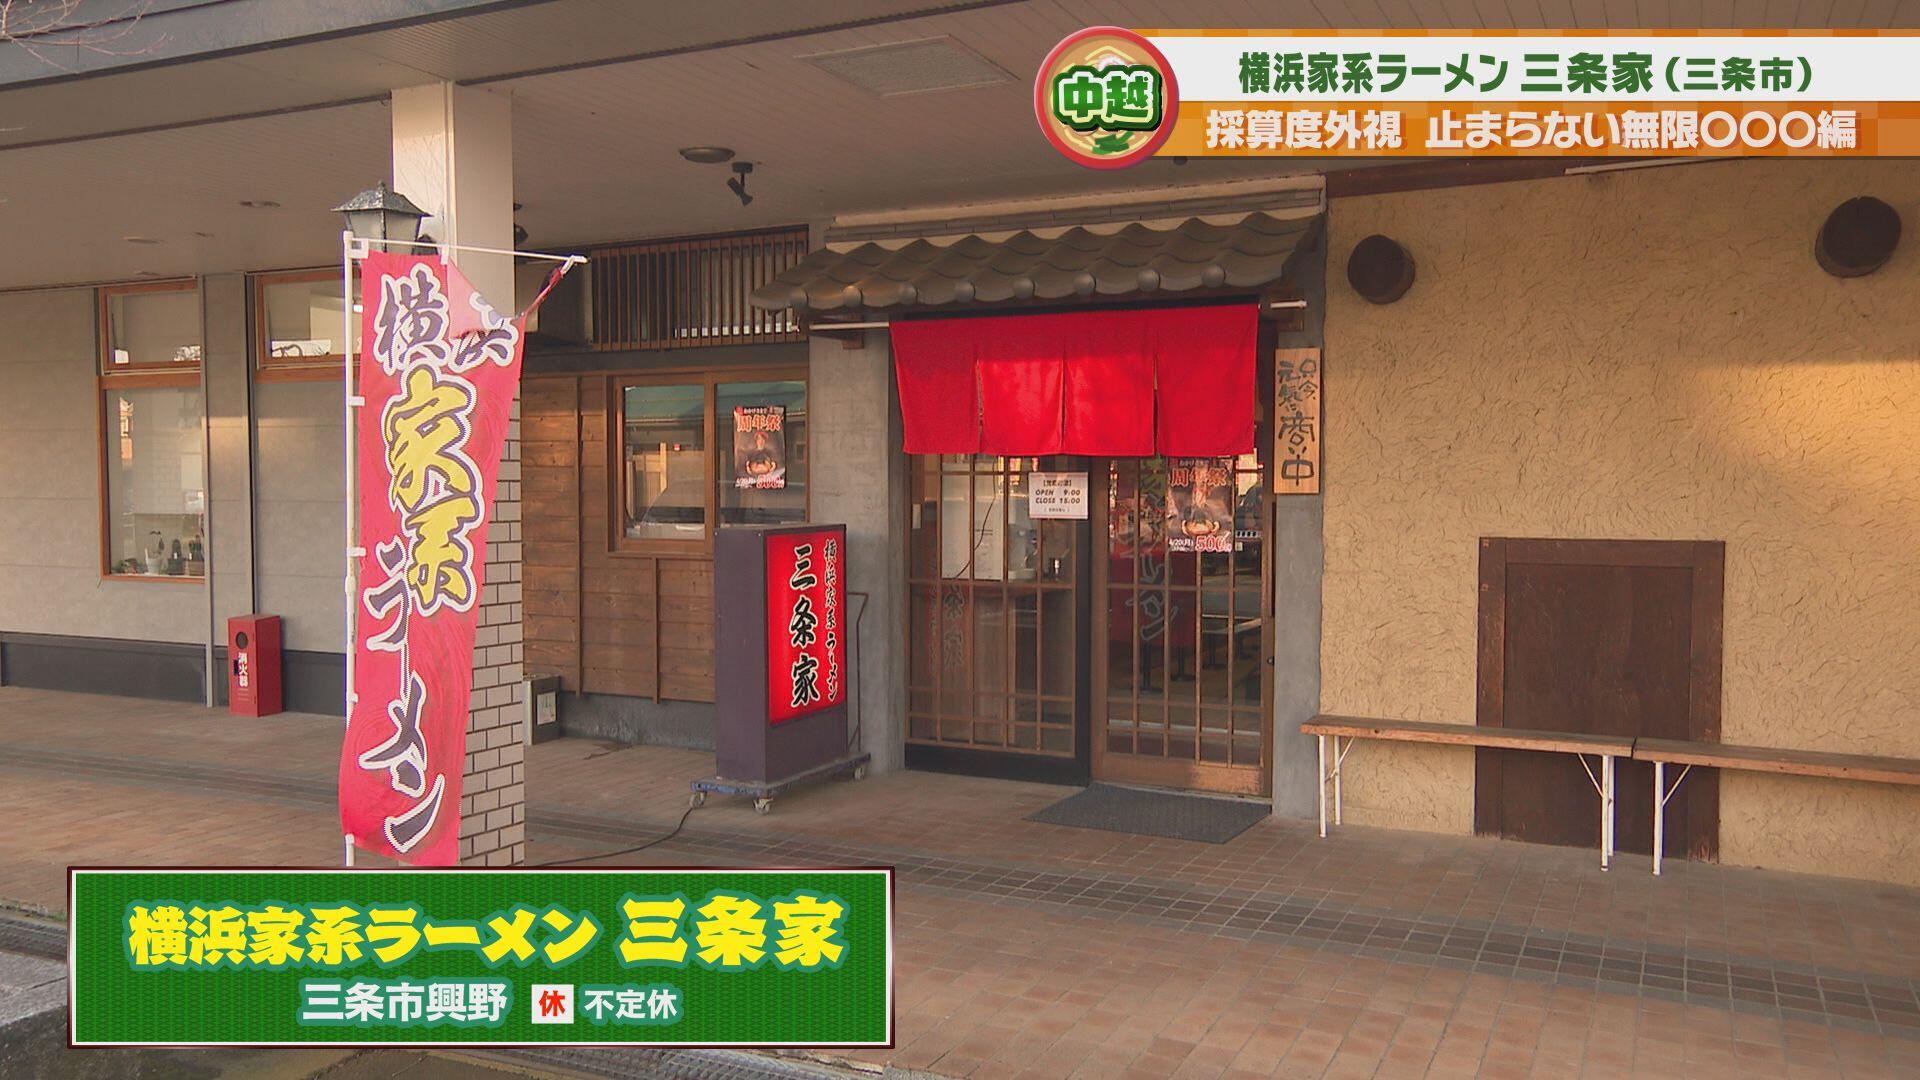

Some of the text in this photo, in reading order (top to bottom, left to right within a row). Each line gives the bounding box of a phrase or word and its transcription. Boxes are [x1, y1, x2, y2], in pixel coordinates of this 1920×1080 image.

[238, 652, 249, 688] 消火器
[789, 543, 821, 708] 三条家
[824, 538, 838, 702] 横浜家系ラーメン
